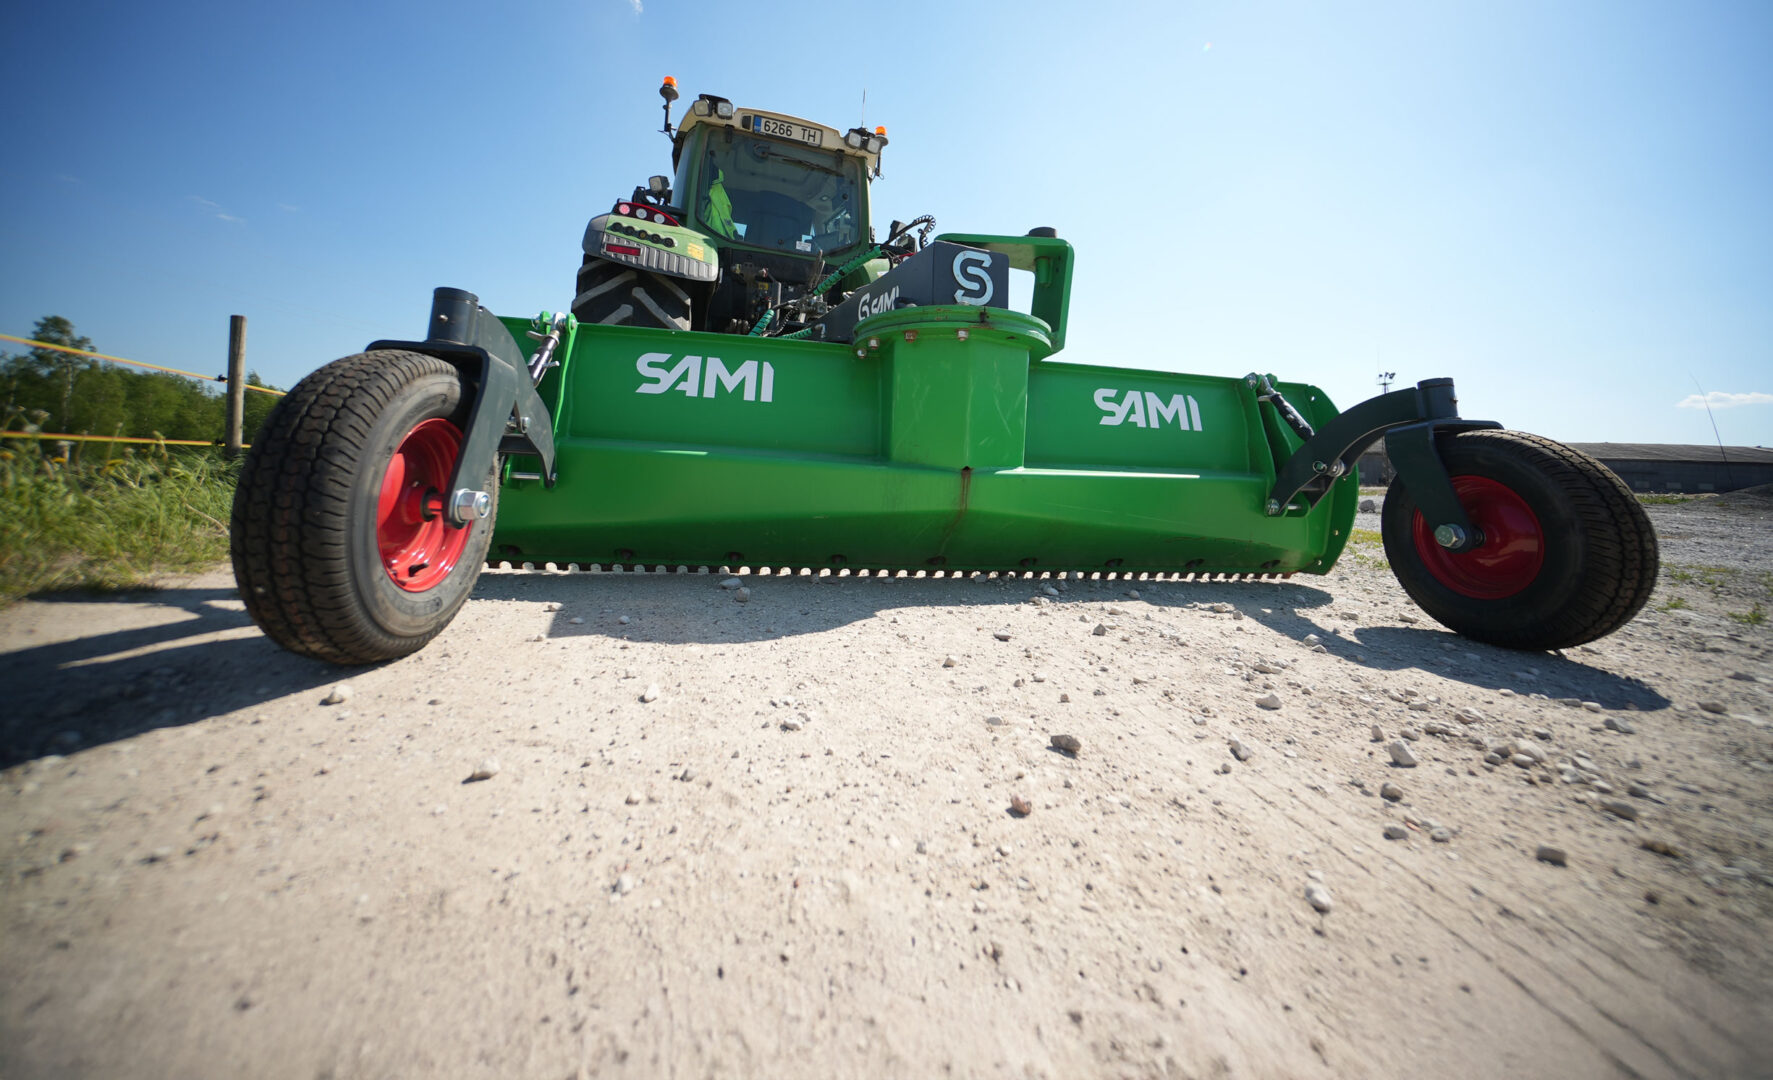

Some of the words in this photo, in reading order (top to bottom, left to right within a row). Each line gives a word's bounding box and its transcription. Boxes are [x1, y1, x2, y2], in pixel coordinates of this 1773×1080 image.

[763, 120, 793, 137] 6266
[801, 127, 817, 143] TH
[634, 351, 775, 403] SAMI
[1093, 388, 1203, 432] SAMI
